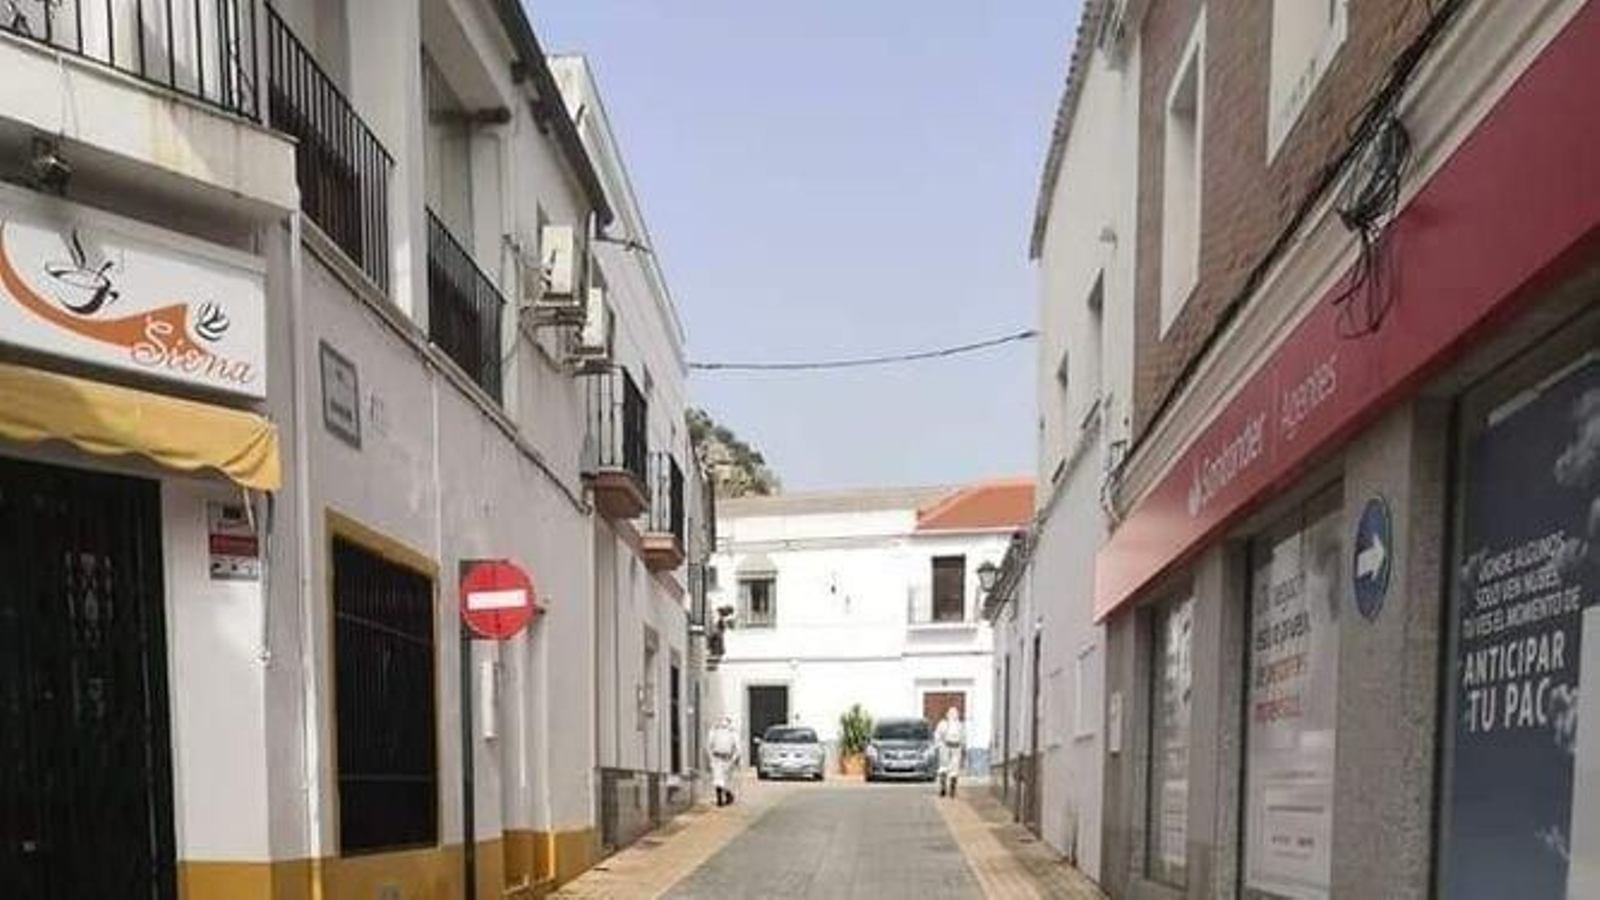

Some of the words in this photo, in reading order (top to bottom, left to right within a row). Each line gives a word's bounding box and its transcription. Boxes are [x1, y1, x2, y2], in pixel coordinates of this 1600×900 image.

[131, 317, 254, 384] Siena
[1203, 411, 1266, 508] Santander
[1507, 591, 1562, 627] MOMENTO
[1463, 630, 1565, 685] ANTICIPAR
[1468, 687, 1497, 732] TU
